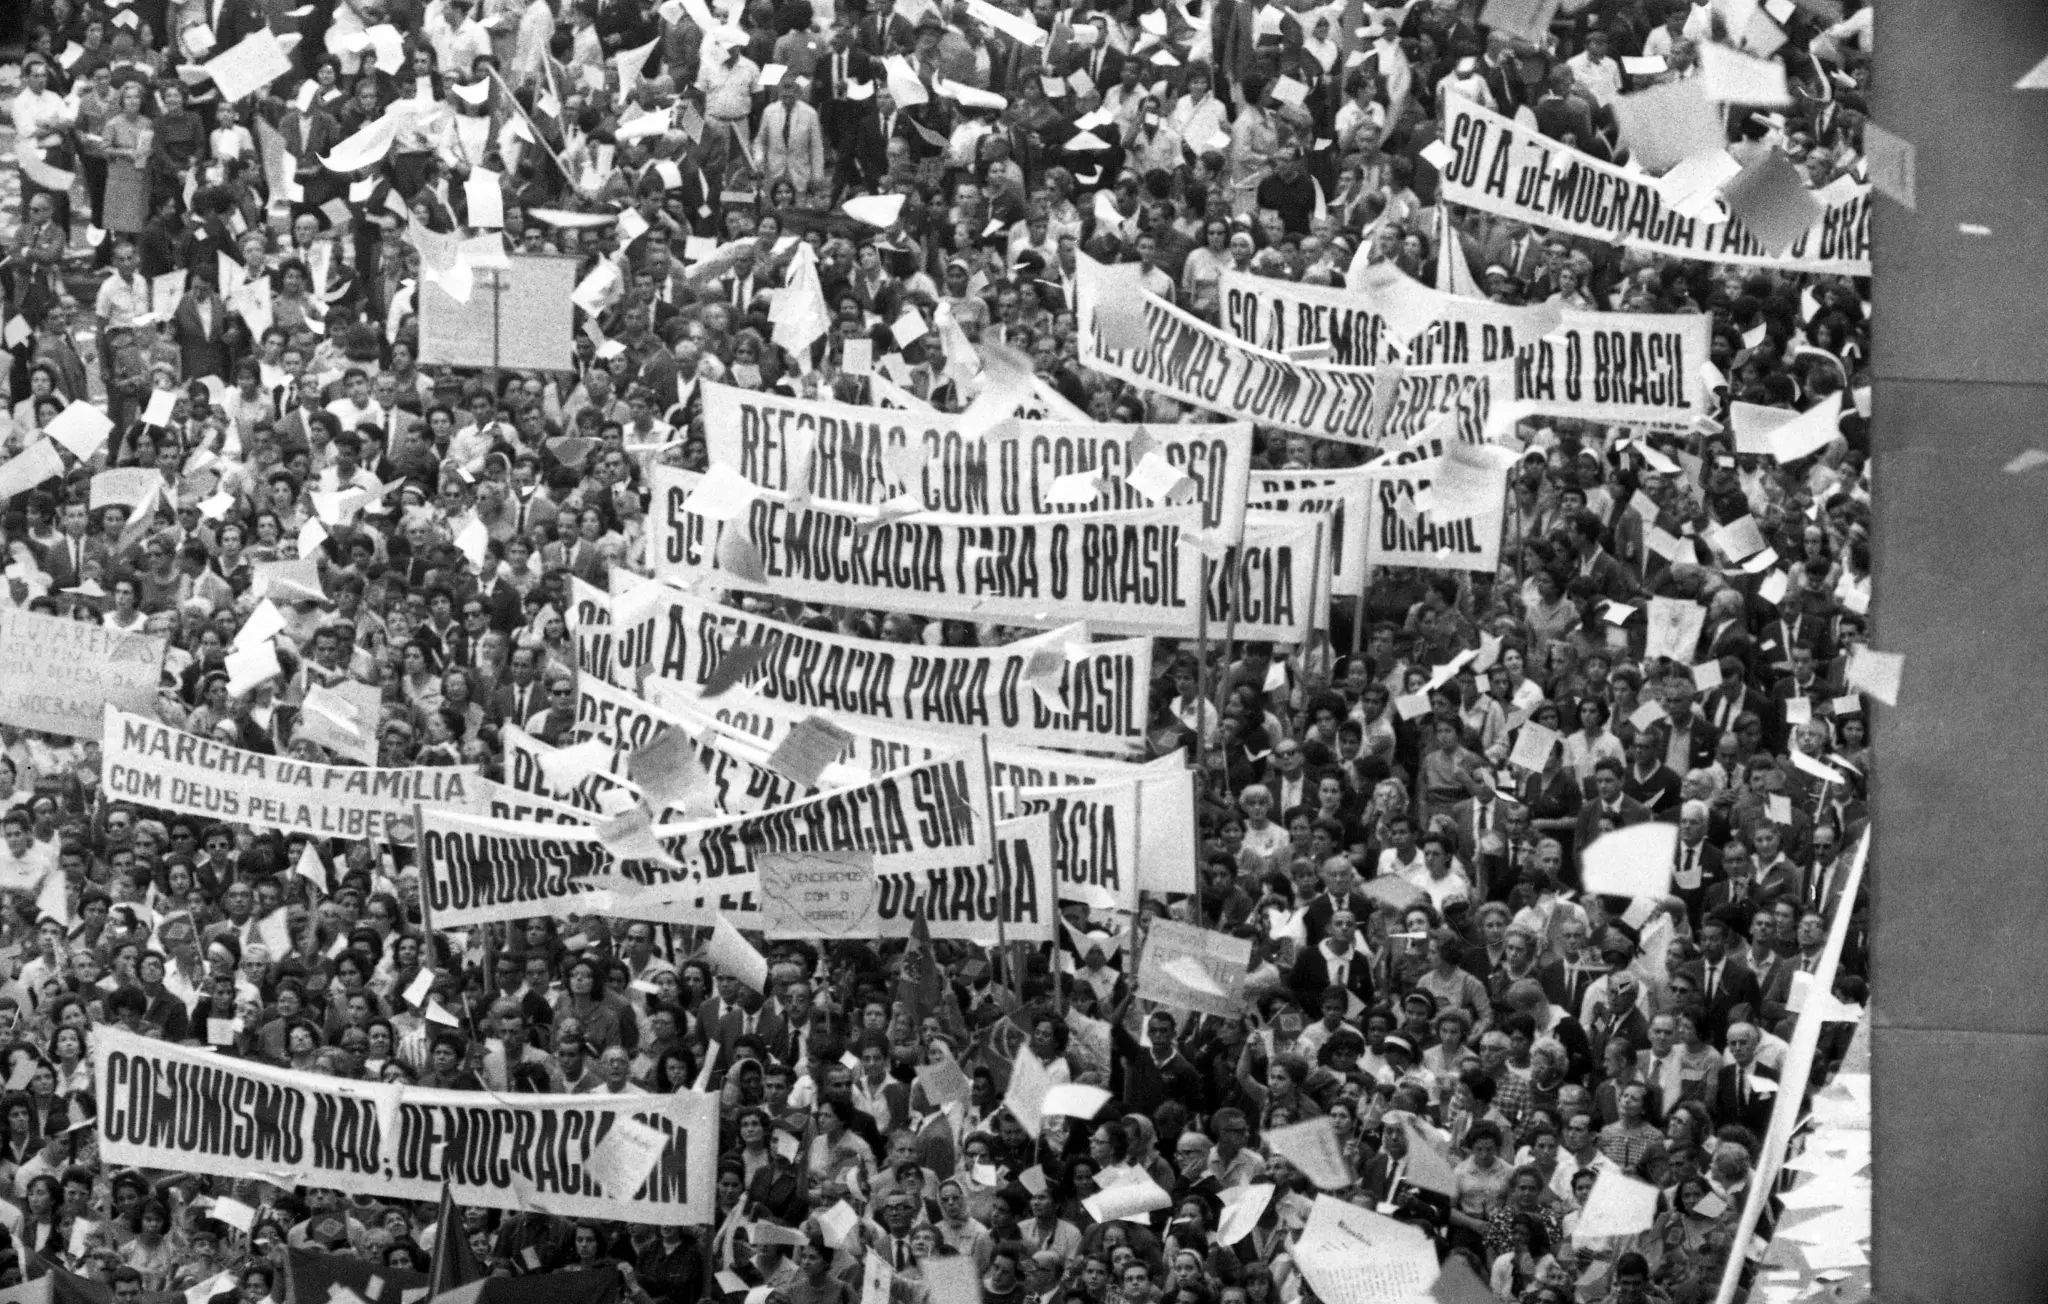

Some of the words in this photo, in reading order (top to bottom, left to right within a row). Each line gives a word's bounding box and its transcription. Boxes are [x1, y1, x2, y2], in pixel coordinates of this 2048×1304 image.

[1566, 330, 1582, 402] O
[1594, 331, 1691, 409] BRASIL
[922, 428, 988, 514] COM
[1030, 434, 1228, 530] CONGSO
[1051, 523, 1070, 600] O
[1082, 523, 1186, 608] BRASIL
[903, 655, 990, 727] PARA
[999, 654, 1024, 728] O
[123, 719, 267, 780] MARCHA
[276, 761, 314, 788] DA
[109, 763, 162, 800] COM
[170, 777, 240, 815] DEUS
[247, 796, 313, 827] PELA
[910, 760, 976, 849] SIM
[104, 1050, 306, 1165] COMUNISMO
